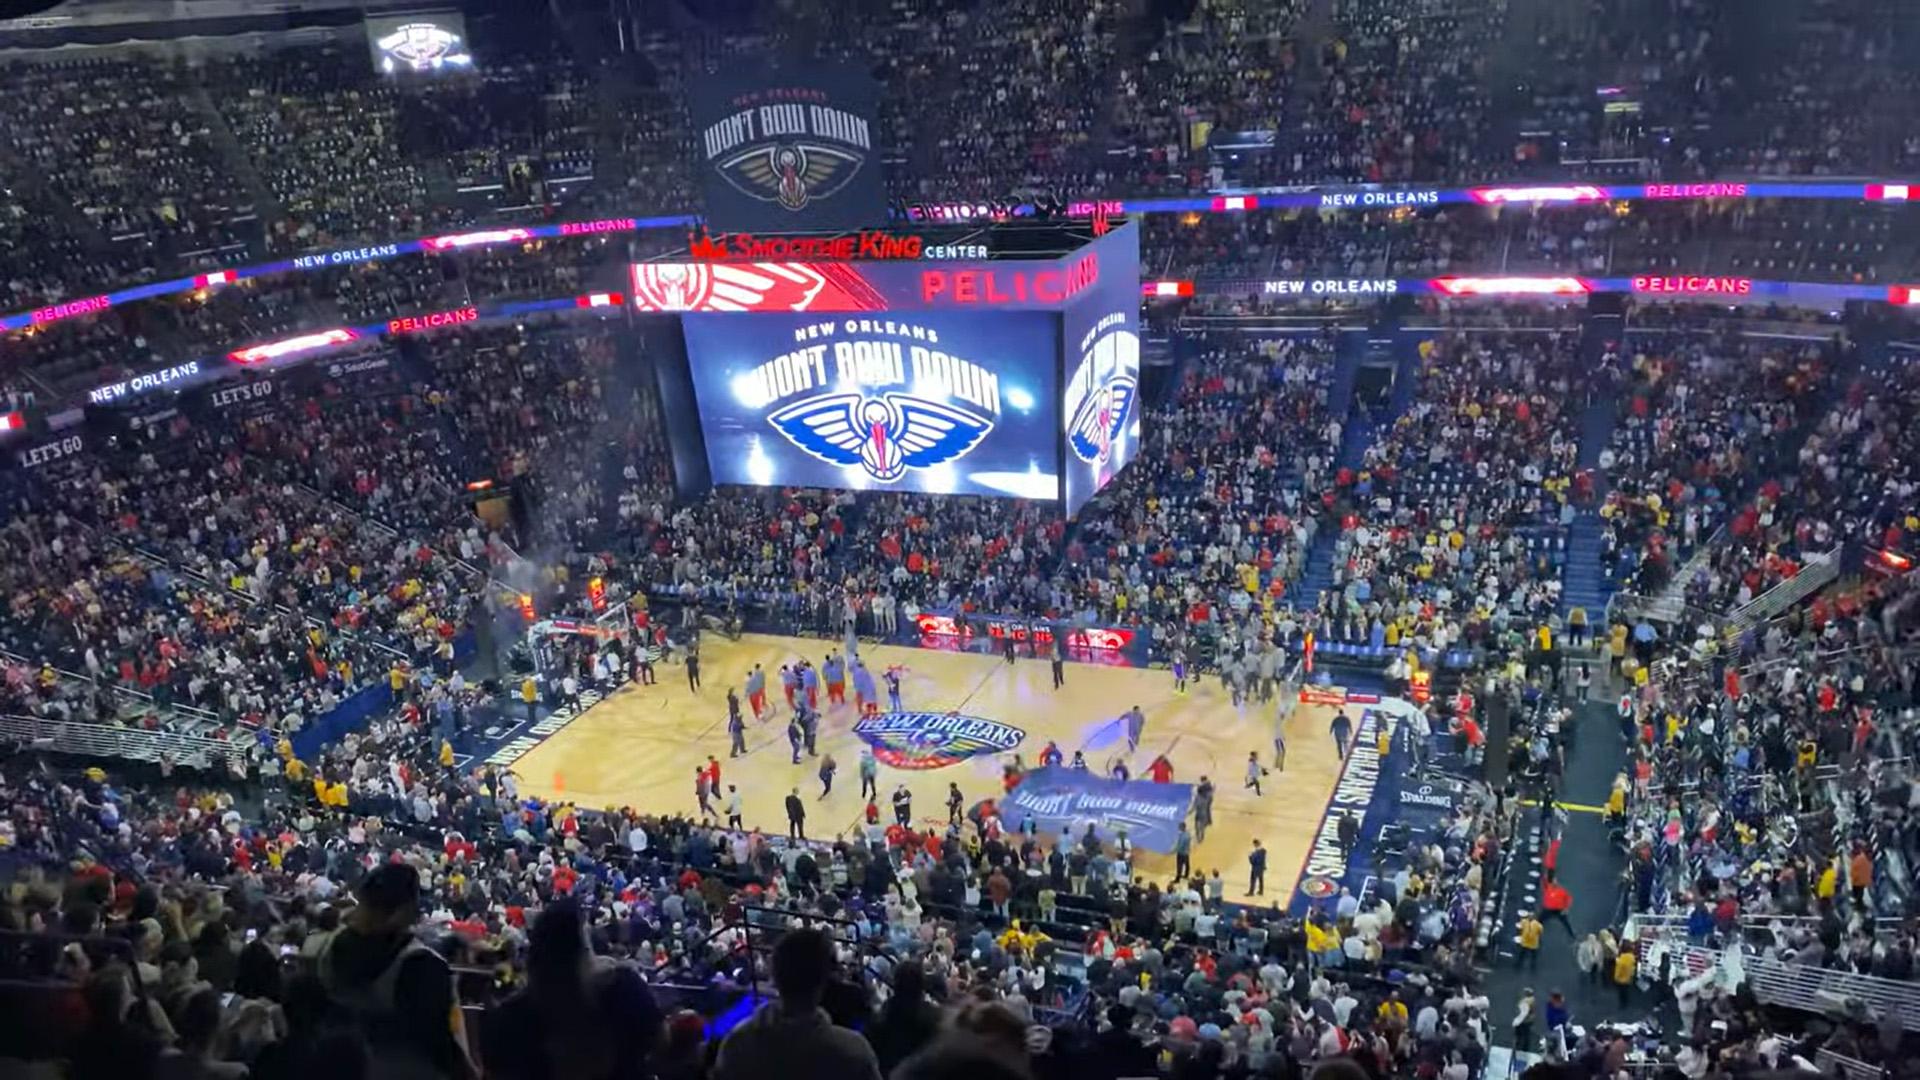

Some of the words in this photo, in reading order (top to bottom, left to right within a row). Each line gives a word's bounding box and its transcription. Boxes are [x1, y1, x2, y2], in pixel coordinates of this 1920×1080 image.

[704, 109, 754, 160] WON'T
[759, 104, 806, 136] BOW
[810, 105, 870, 150] DOWN
[1322, 194, 1357, 206] NEW
[1363, 191, 1438, 205] ORLEANS
[1646, 184, 1746, 197] PELICANS
[562, 218, 636, 234] PELICANS
[294, 255, 326, 268] NEW
[332, 244, 397, 263] ORLEANS
[925, 246, 988, 259] CENTER
[922, 252, 1098, 304] PELICANS
[1265, 281, 1304, 294] NEW
[1311, 280, 1397, 293] ORLEANS
[1635, 277, 1750, 294] PELICANS
[34, 295, 110, 323] PELICANS
[390, 308, 478, 332] PELICANS
[795, 322, 835, 342] NEW
[845, 320, 938, 342] ORLEANS
[91, 382, 126, 403] NEW
[131, 361, 198, 391] ORLEANS
[834, 341, 904, 384] BOW
[910, 346, 1000, 416] DOWN
[212, 386, 251, 407] LET'S
[253, 380, 272, 396] GO
[22, 443, 62, 468] LET'S
[63, 435, 83, 454] GO
[923, 715, 1024, 748] ORLEANS
[1334, 746, 1381, 806] ORLEANS
[1400, 791, 1451, 808] SPALDING
